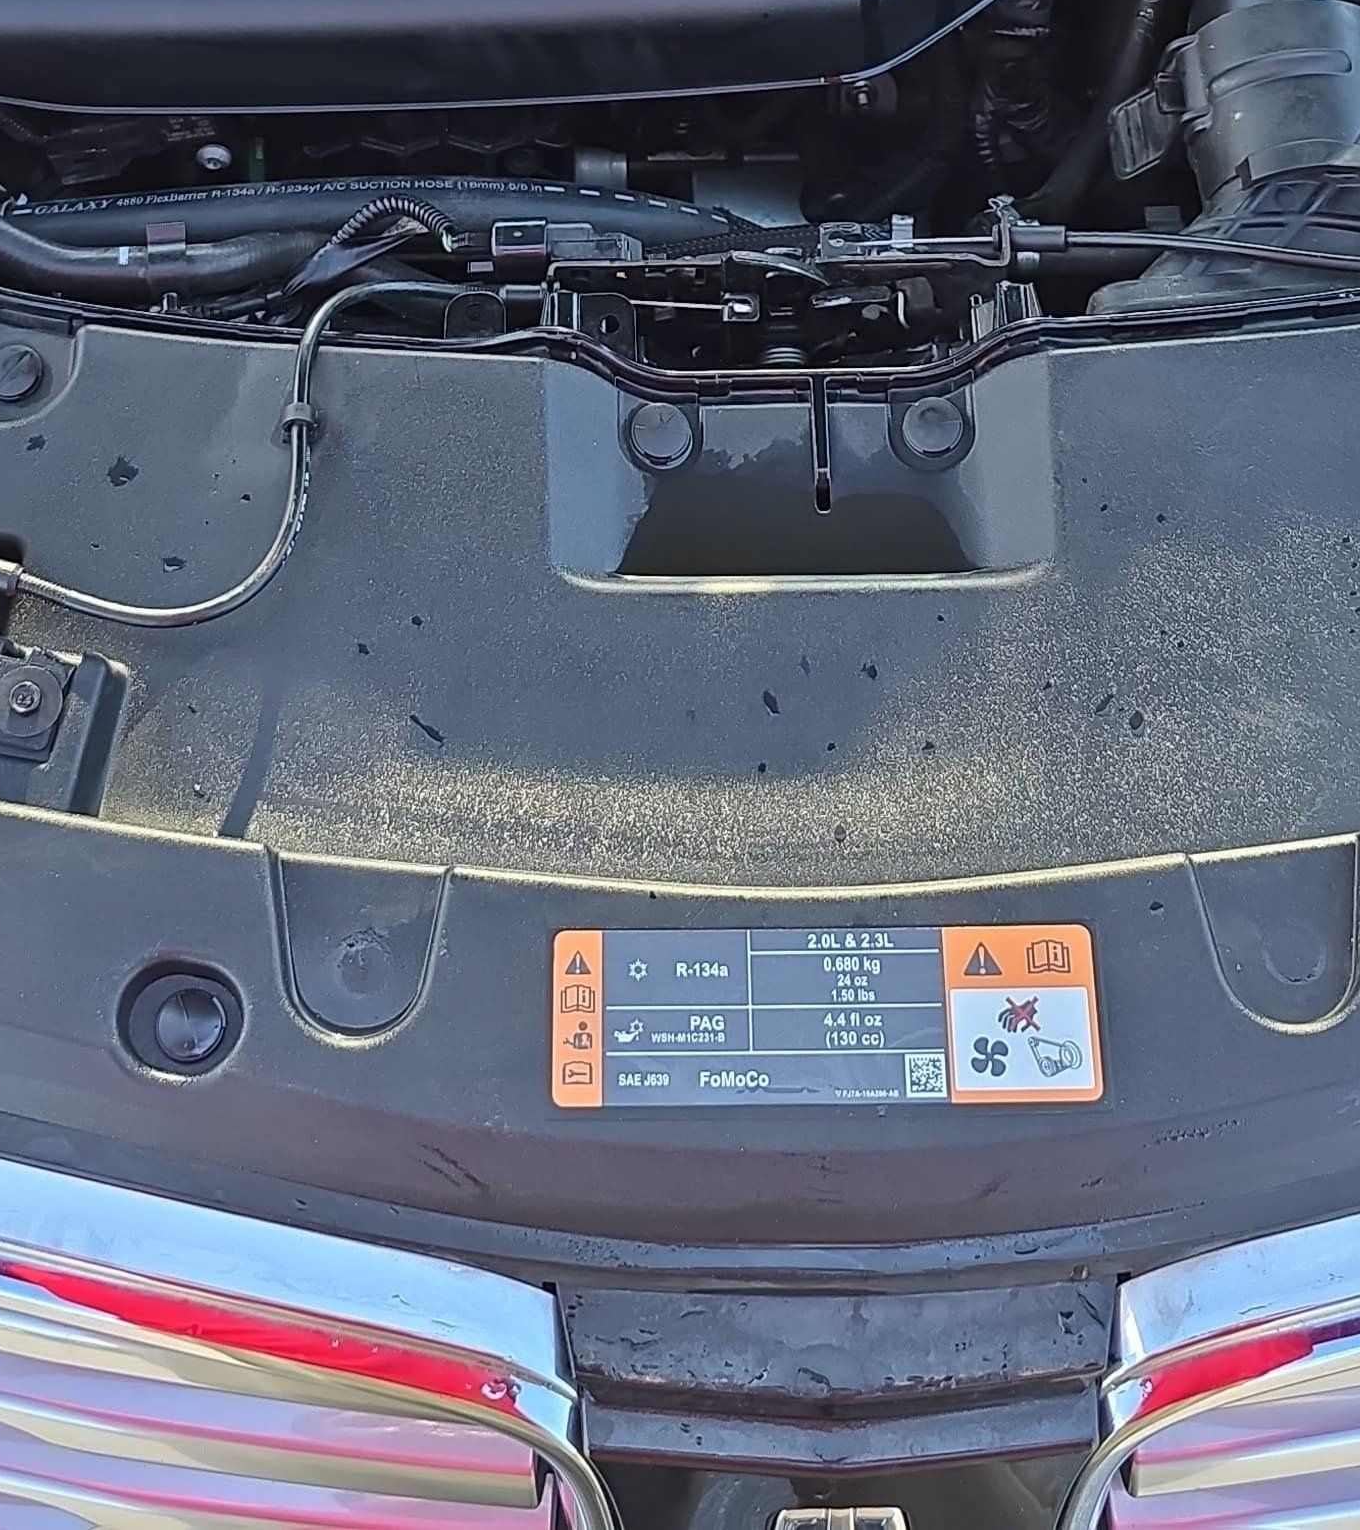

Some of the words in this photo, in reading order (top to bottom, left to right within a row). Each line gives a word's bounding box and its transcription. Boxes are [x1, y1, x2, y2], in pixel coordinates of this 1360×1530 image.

[34, 198, 113, 215] GALAXY
[116, 196, 143, 208] 4880
[145, 190, 208, 205] FlexBarrier
[211, 187, 255, 199] R-134a
[265, 182, 321, 196] R-1234yf
[322, 181, 346, 192] A/C
[350, 179, 412, 191] SUCTION
[414, 178, 454, 190] HOSE
[807, 934, 841, 950] 2.0L
[844, 933, 857, 949] &
[861, 932, 894, 949] 2.3L
[675, 962, 729, 978] R-134a
[823, 956, 860, 972] 0.680
[863, 956, 881, 975] kg
[837, 974, 852, 987] 24
[854, 977, 868, 987] oz
[831, 989, 856, 1002] 1.50
[858, 989, 876, 1002] lbs
[690, 1015, 725, 1031] PAG
[824, 1013, 846, 1027] 4.4
[849, 1013, 861, 1027] fl
[864, 1015, 883, 1027] oz
[651, 1032, 726, 1043] WSH-M1C231-B
[825, 1031, 858, 1048] (130
[861, 1031, 885, 1048] cc)
[618, 1073, 642, 1087] SAE
[643, 1073, 670, 1087] J639
[699, 1071, 770, 1088] FoMoCo
